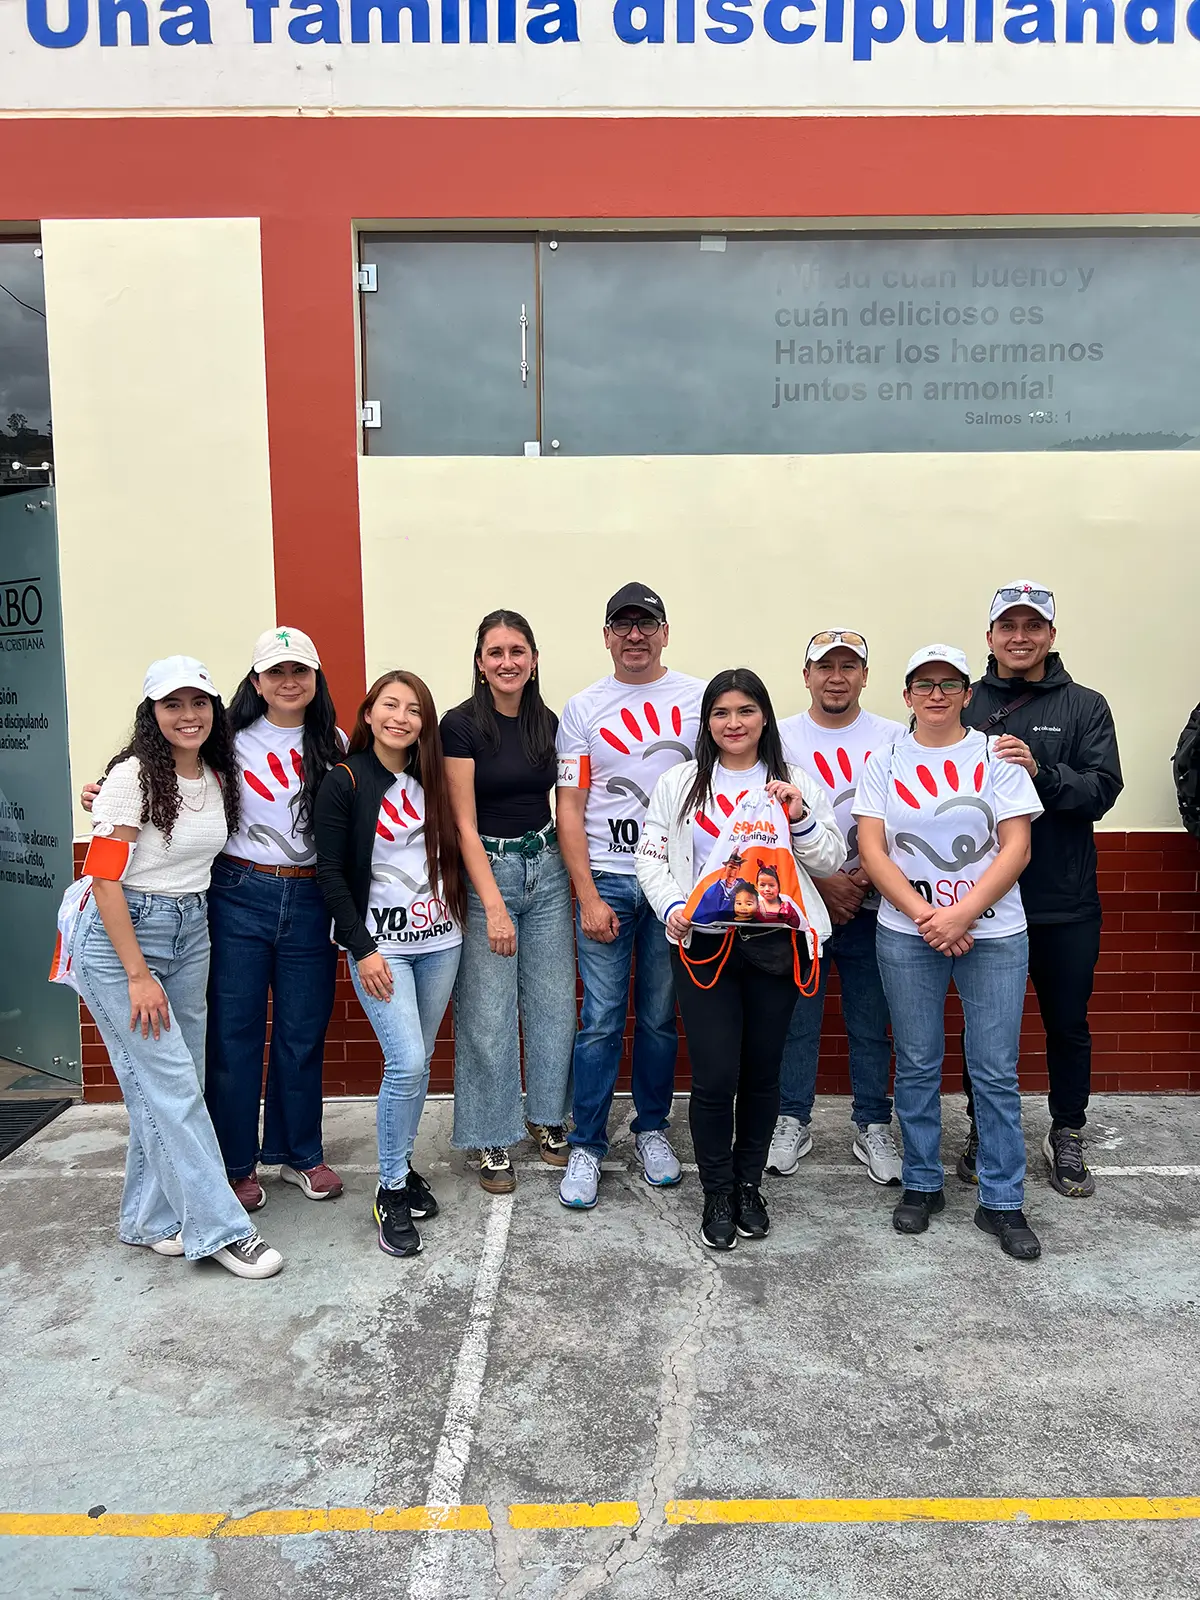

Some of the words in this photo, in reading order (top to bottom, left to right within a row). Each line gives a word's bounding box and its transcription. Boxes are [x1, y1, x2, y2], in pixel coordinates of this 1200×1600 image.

[26, 0, 213, 48] Una
[246, 0, 580, 44] familia
[612, 0, 1200, 61] discipuland
[972, 264, 1067, 288] bueno
[1077, 267, 1095, 292] y
[774, 302, 848, 327] cuán
[859, 301, 998, 326] delicioso
[1009, 305, 1044, 325] es
[775, 339, 885, 365] Habitar
[895, 339, 940, 364] los
[952, 338, 1104, 363] hermanos
[772, 376, 867, 408] juntos
[877, 381, 913, 401] en
[923, 374, 1054, 401] armonía!
[964, 411, 1022, 425] Salmos
[1064, 410, 1071, 423] 1
[5, 637, 45, 651] CRISTIANA
[4, 713, 48, 732] discipulando
[31, 829, 59, 848] alcancen
[607, 818, 639, 845] YO
[25, 850, 45, 869] Cristo,
[370, 906, 407, 934] YO
